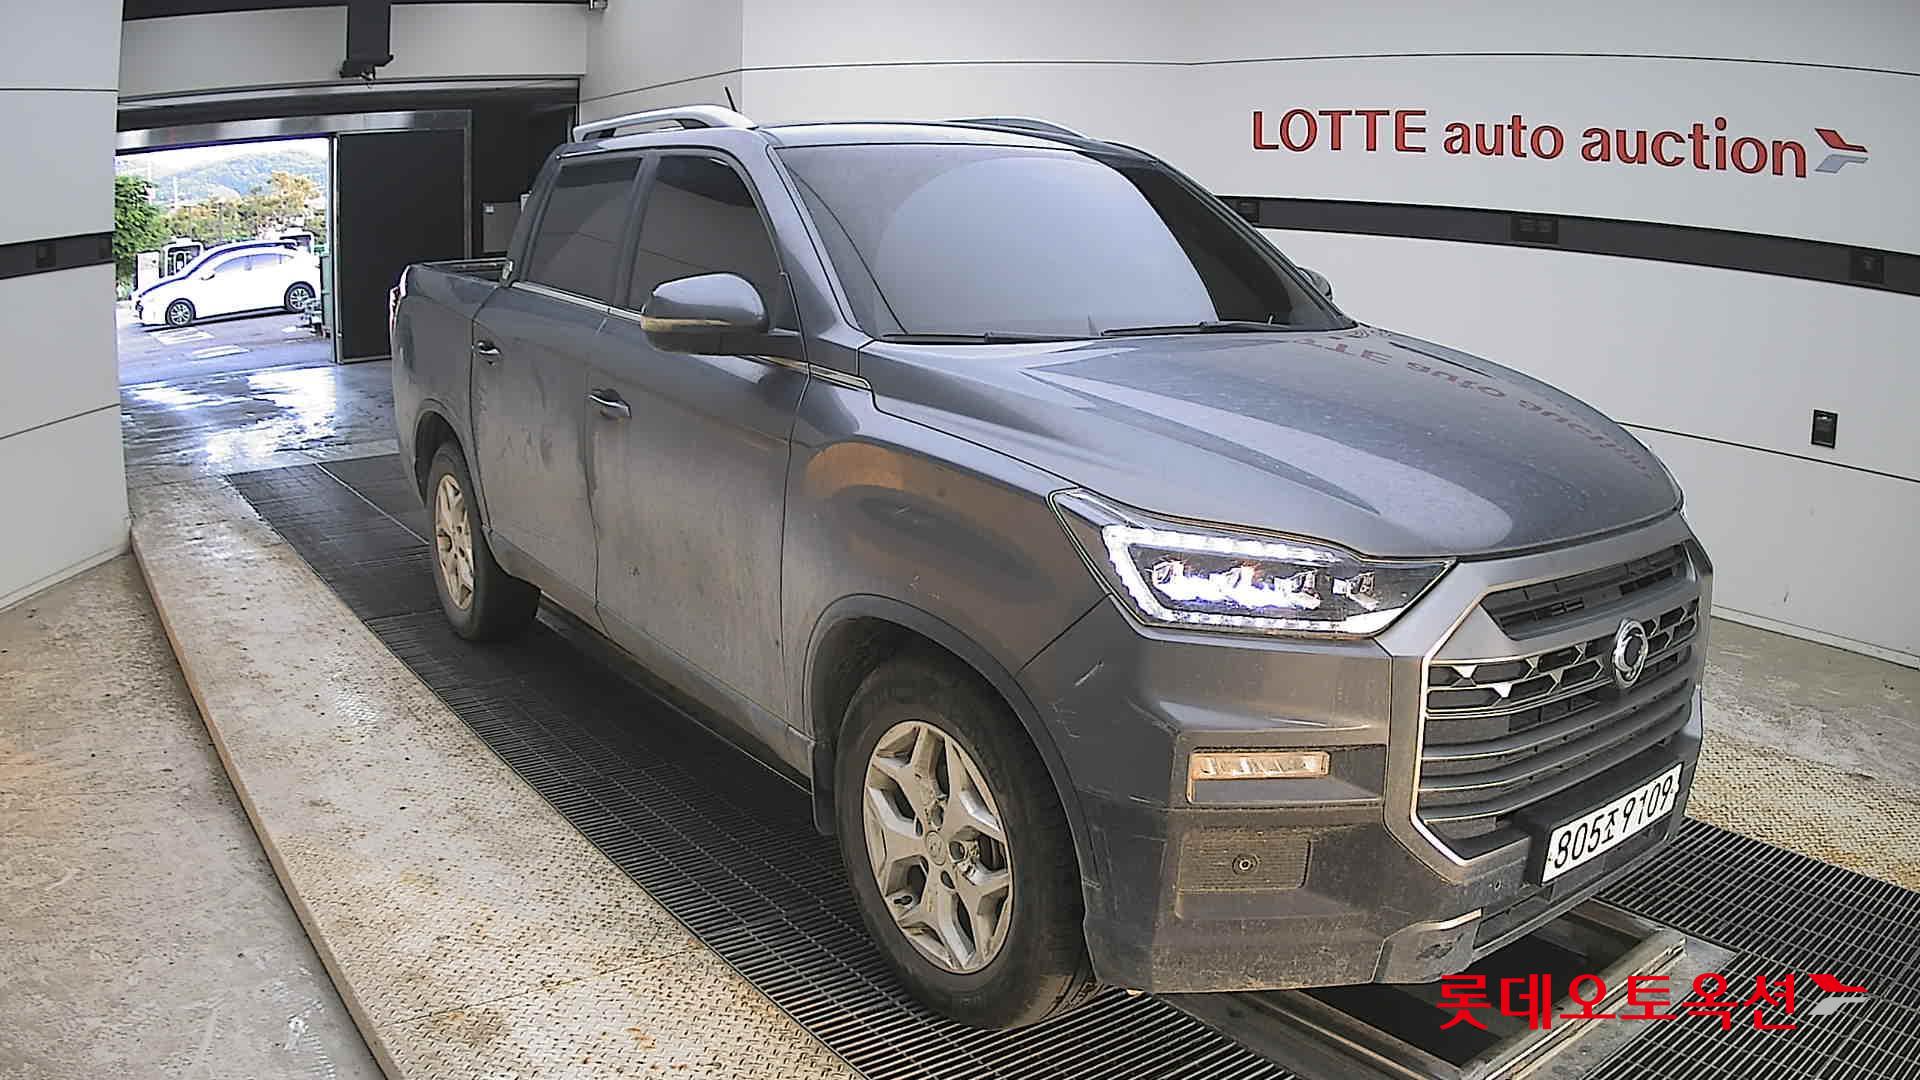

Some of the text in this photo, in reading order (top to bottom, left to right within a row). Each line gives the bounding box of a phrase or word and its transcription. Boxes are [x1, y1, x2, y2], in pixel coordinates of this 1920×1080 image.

[1252, 109, 1807, 178] LOTTE auto auction
